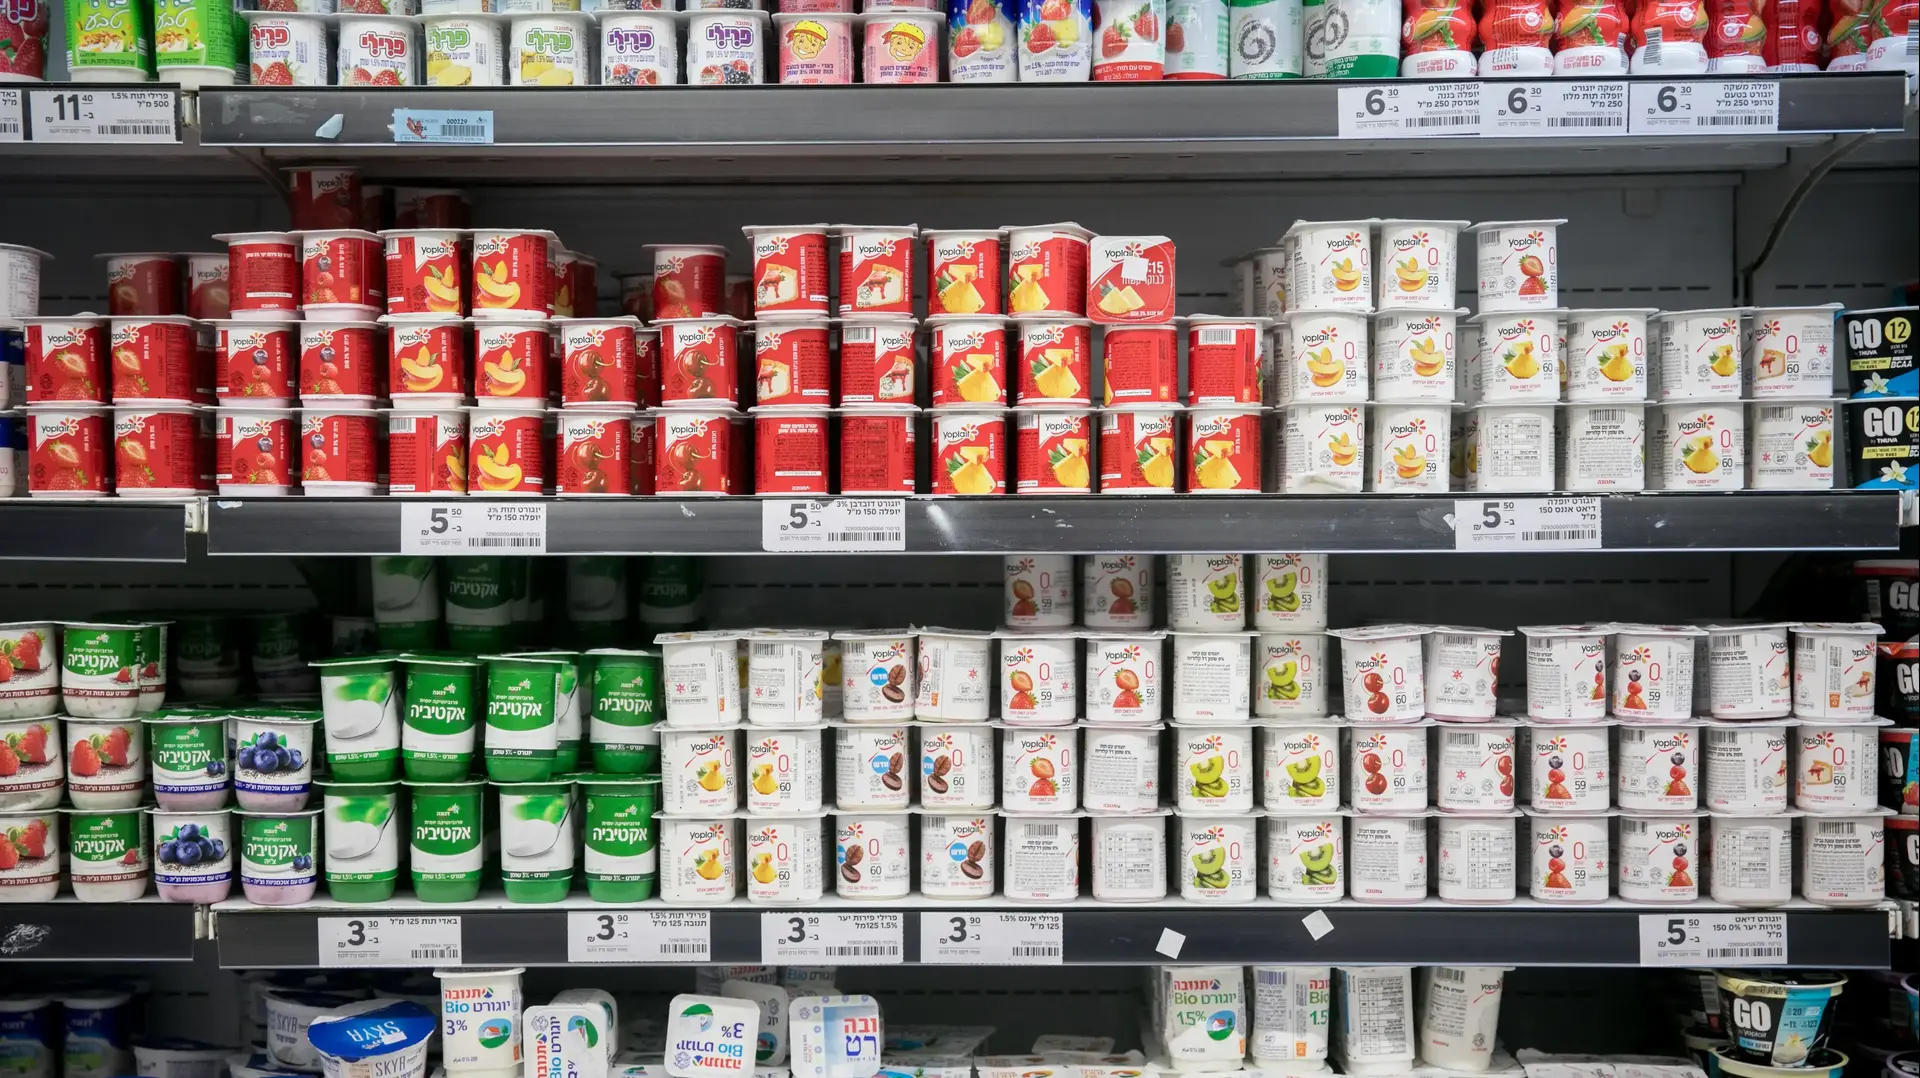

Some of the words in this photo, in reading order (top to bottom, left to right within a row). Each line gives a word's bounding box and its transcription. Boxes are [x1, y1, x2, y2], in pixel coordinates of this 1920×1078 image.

[1454, 84, 1479, 92] משקה
[1366, 89, 1385, 115] 6
[1452, 100, 1479, 108] אפרסק
[1508, 88, 1527, 114] 6
[1563, 93, 1580, 101] מלון
[1658, 86, 1677, 112] 6
[52, 94, 79, 121] 11
[1428, 276, 1438, 286] 59
[1850, 319, 1882, 350] GO
[1890, 321, 1907, 339] 12
[1787, 364, 1799, 373] 60
[1891, 359, 1913, 368] BCAA
[1864, 406, 1903, 437] GO
[850, 501, 875, 509] דובדבן
[431, 508, 448, 533] 5
[790, 504, 808, 529] 5
[1483, 502, 1501, 528] 5
[68, 654, 119, 670] אקטיביה
[411, 705, 465, 723] אקטיביה
[489, 702, 542, 719] אקטיביה
[599, 698, 652, 716] אקטיביה
[159, 750, 210, 765] אקטיביה
[953, 777, 964, 786] 60
[1231, 779, 1240, 788] 53
[416, 825, 471, 844] אקטיביה
[593, 826, 647, 845] אקטיביה
[74, 838, 125, 854] אקטיביה
[247, 843, 297, 859] אקטיביה
[1574, 870, 1586, 879] 59
[649, 911, 667, 919] 1.5%
[347, 921, 365, 946] 3
[597, 915, 614, 940] 3
[788, 917, 805, 942] 3
[949, 917, 967, 942] 3
[1668, 919, 1686, 945] 5
[1174, 980, 1210, 990] תנובה
[445, 989, 482, 999] תנובה
[1175, 992, 1197, 1004] Bio
[1201, 994, 1236, 1004] יוגורט
[445, 1002, 469, 1013] Bio
[473, 1001, 510, 1012] יוגורט
[1733, 998, 1771, 1032] GO
[276, 1014, 298, 1031] SKYR
[1177, 1011, 1206, 1025] 1.5%
[347, 1021, 401, 1039] SKYR
[446, 1019, 468, 1035] 3%
[552, 1016, 561, 1053] יוגורט
[721, 1022, 744, 1038] 3%
[676, 1040, 714, 1052] יוגורט
[718, 1043, 743, 1057] Bio
[375, 1056, 406, 1076] SKYR
